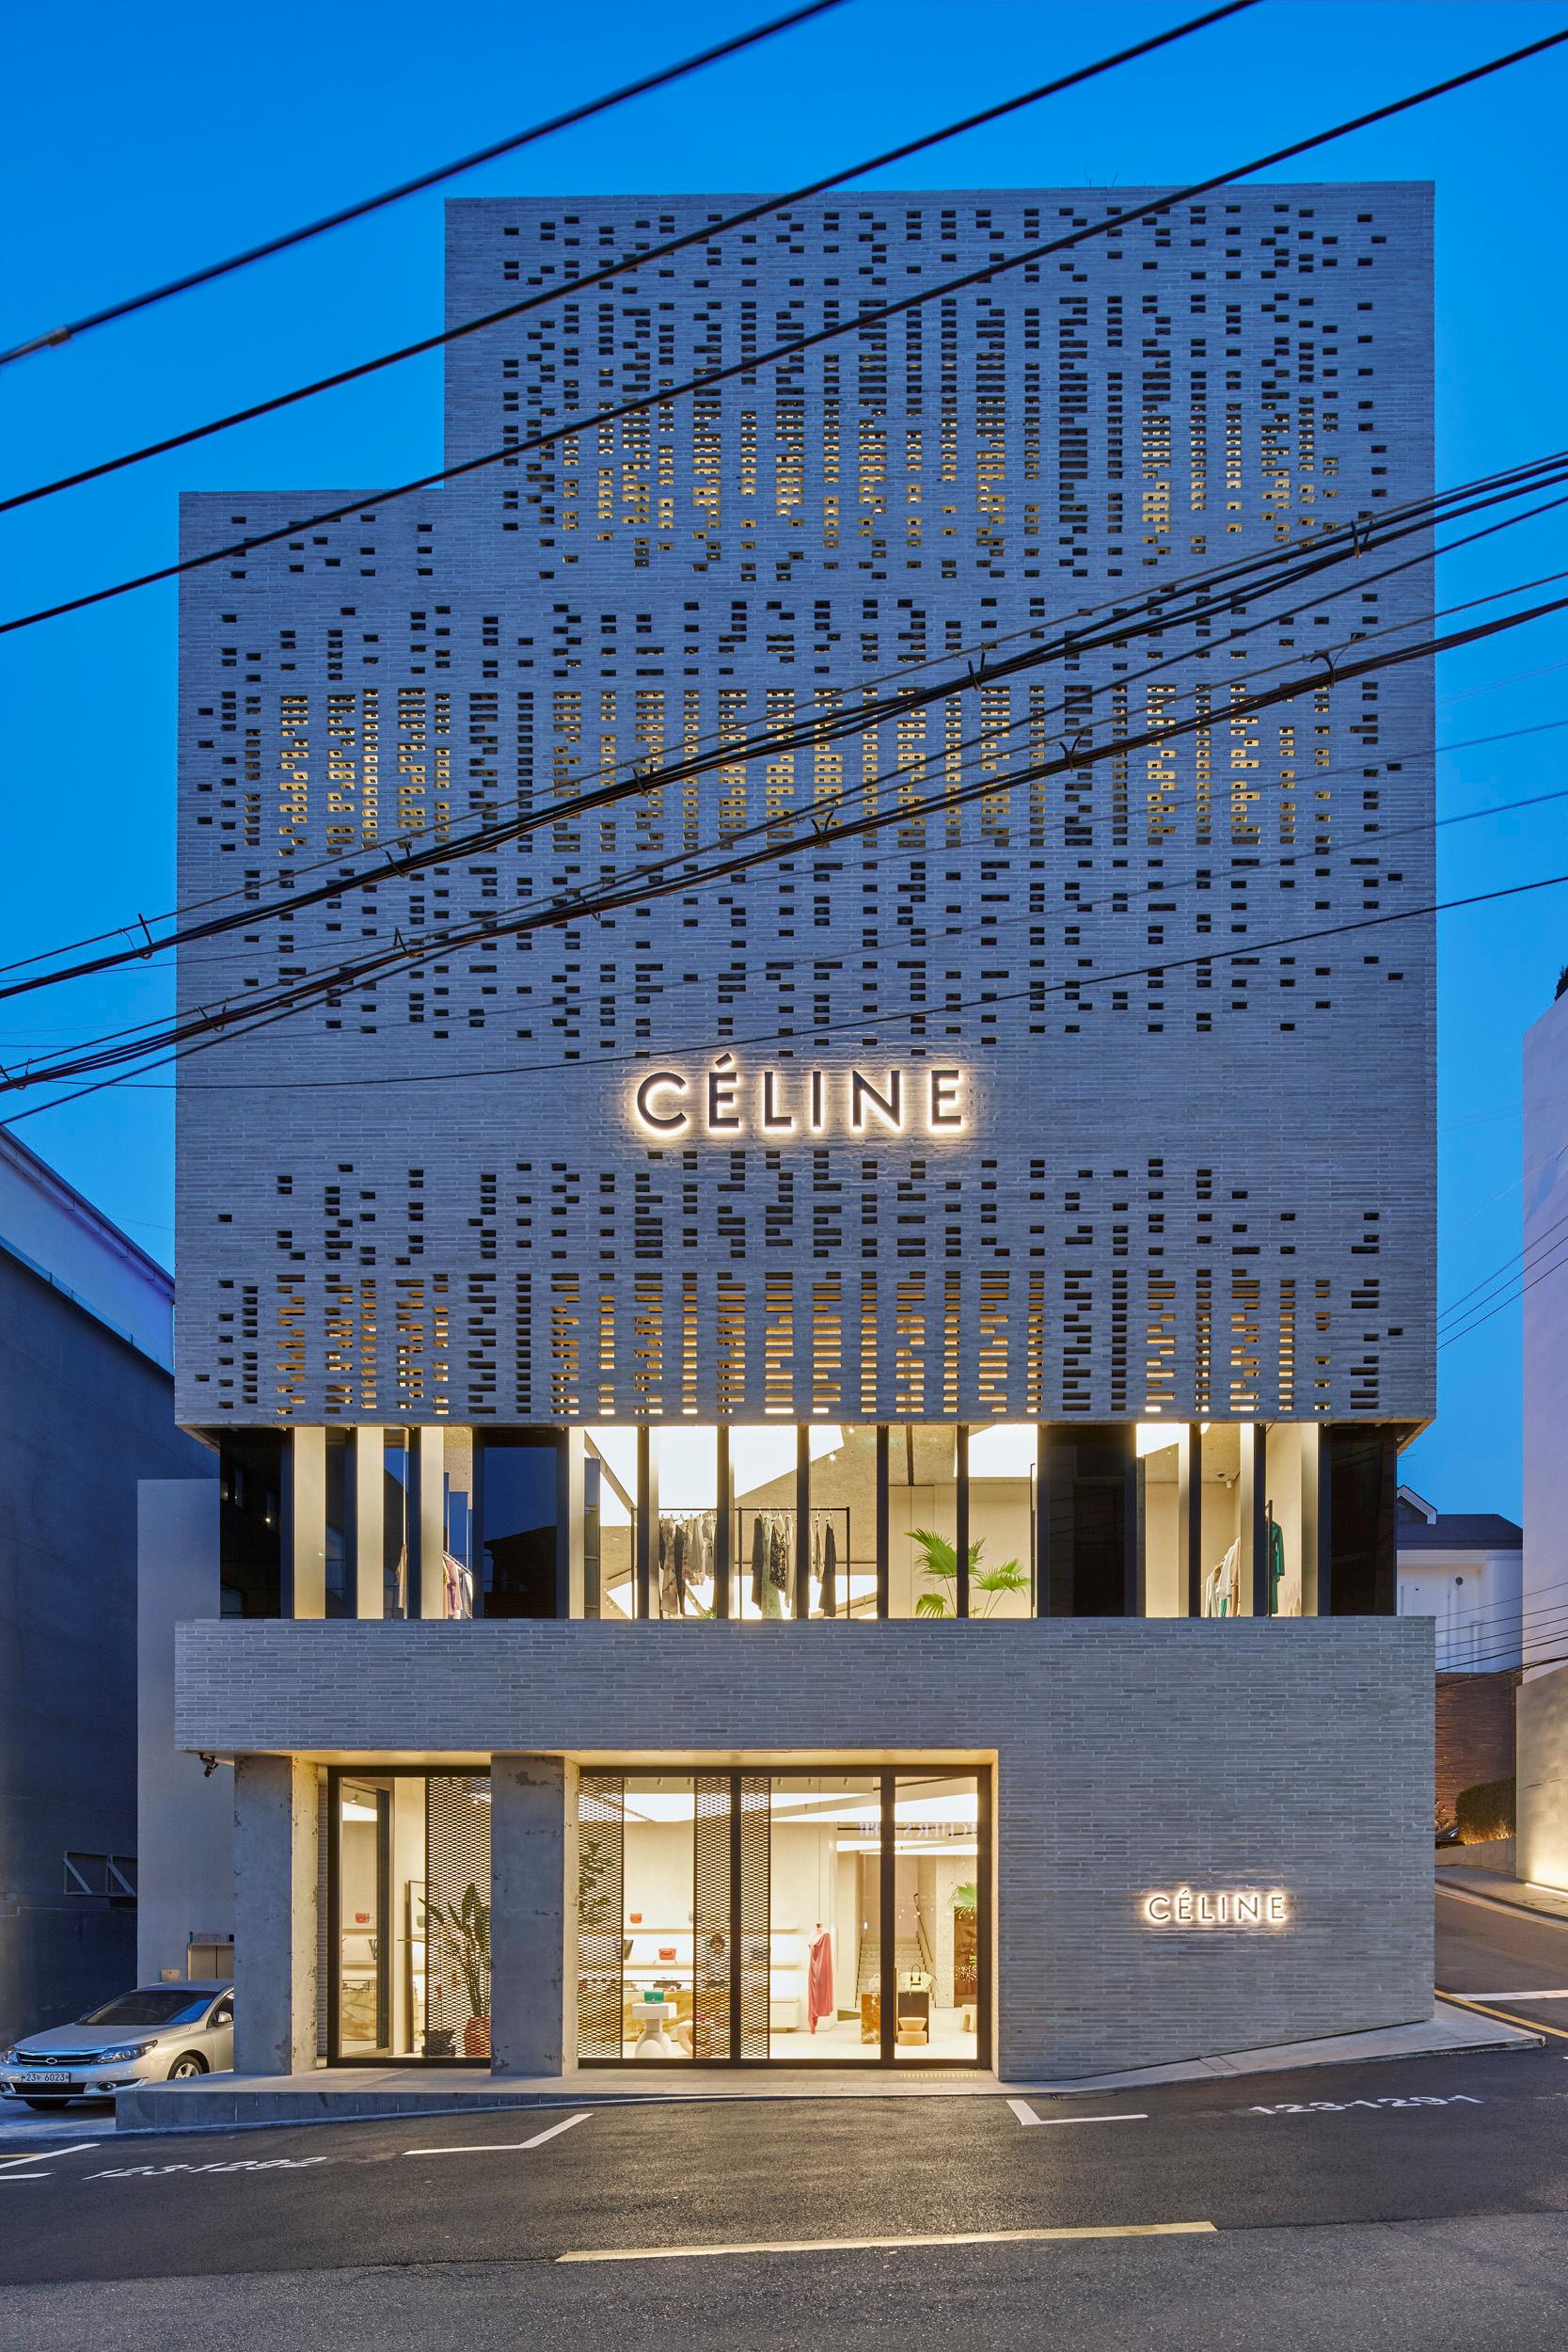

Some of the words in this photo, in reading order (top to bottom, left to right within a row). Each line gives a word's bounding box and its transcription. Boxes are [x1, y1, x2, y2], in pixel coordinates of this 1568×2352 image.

[637, 1053, 962, 1131] CÉLINE
[1148, 1889, 1284, 1920] CÉLINE
[44, 2073, 65, 2082] 6023
